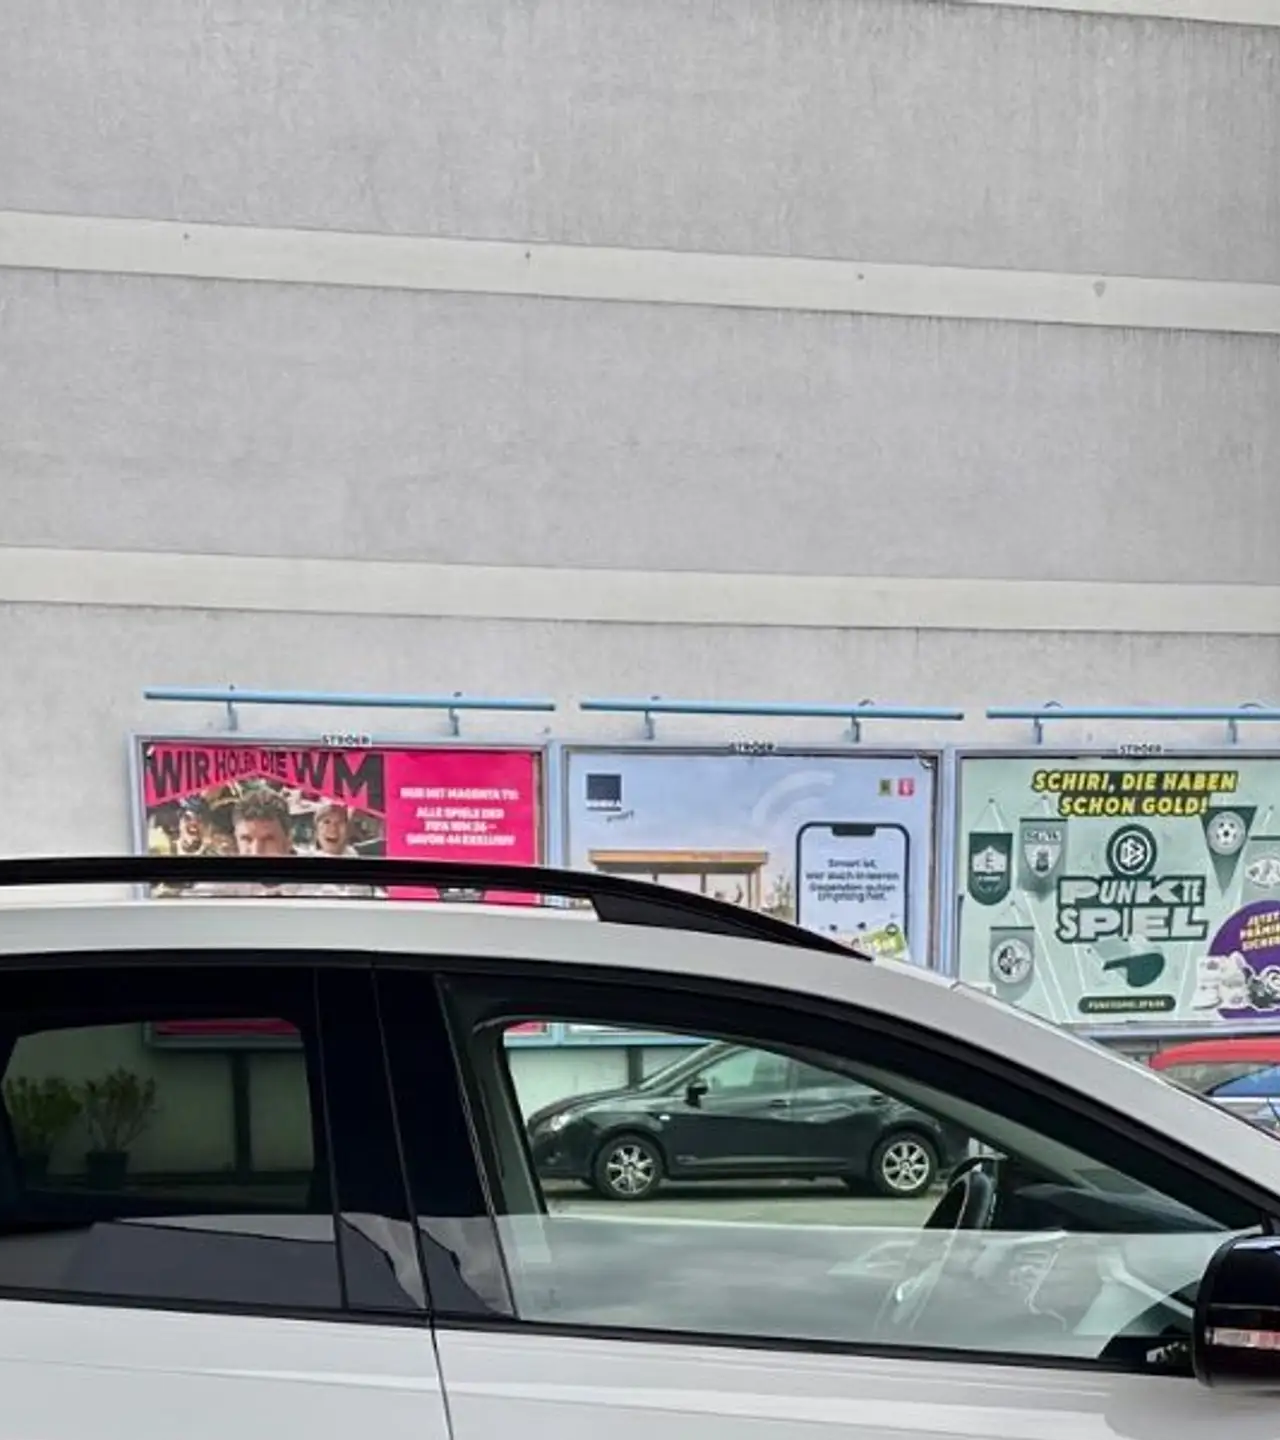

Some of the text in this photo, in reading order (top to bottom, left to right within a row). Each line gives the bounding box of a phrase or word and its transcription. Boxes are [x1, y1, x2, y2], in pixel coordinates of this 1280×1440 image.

[152, 749, 211, 799] WIR
[260, 750, 287, 774] DIE
[289, 750, 384, 812] WM
[1033, 771, 1238, 793] SCHIRI, DIE HABEN
[1060, 795, 1208, 815] SCHON GOLD!
[1057, 905, 1208, 942] SPIEL
